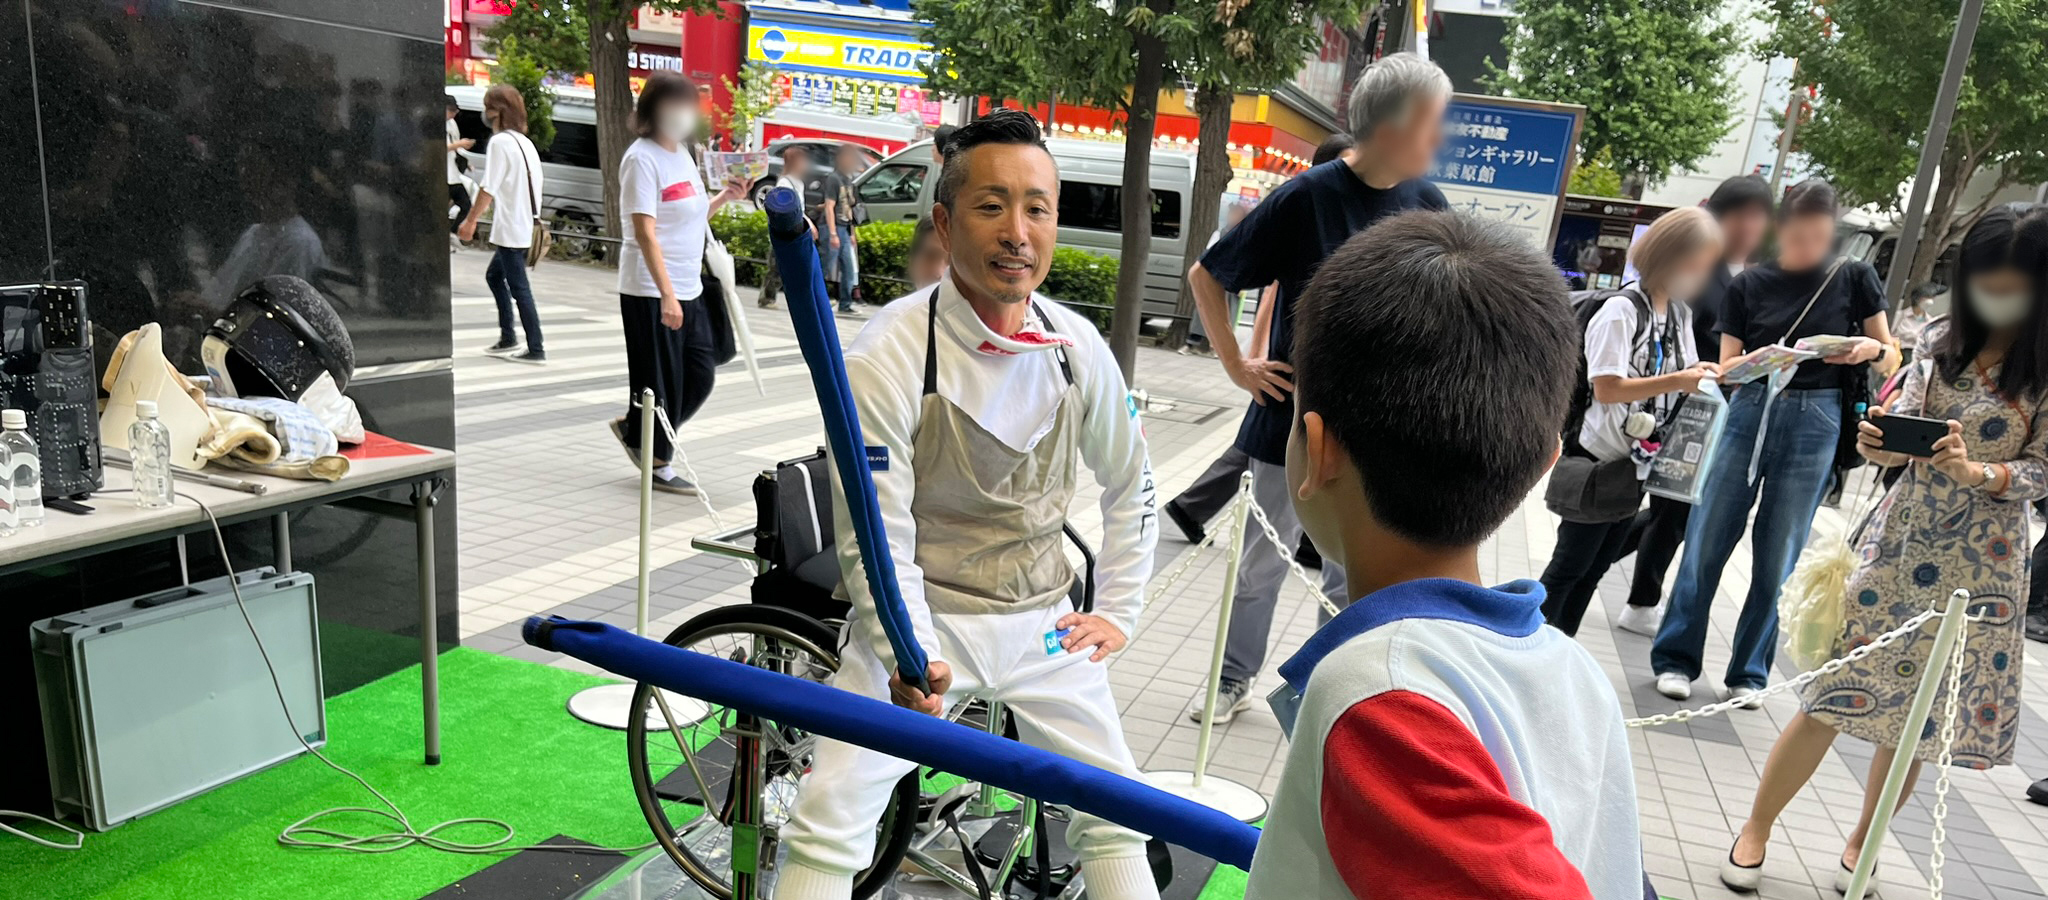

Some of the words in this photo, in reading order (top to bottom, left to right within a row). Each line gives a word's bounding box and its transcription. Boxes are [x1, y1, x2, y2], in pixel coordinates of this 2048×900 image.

[1448, 121, 1510, 142] 友不動産
[1445, 143, 1556, 168] ョンギャラリー
